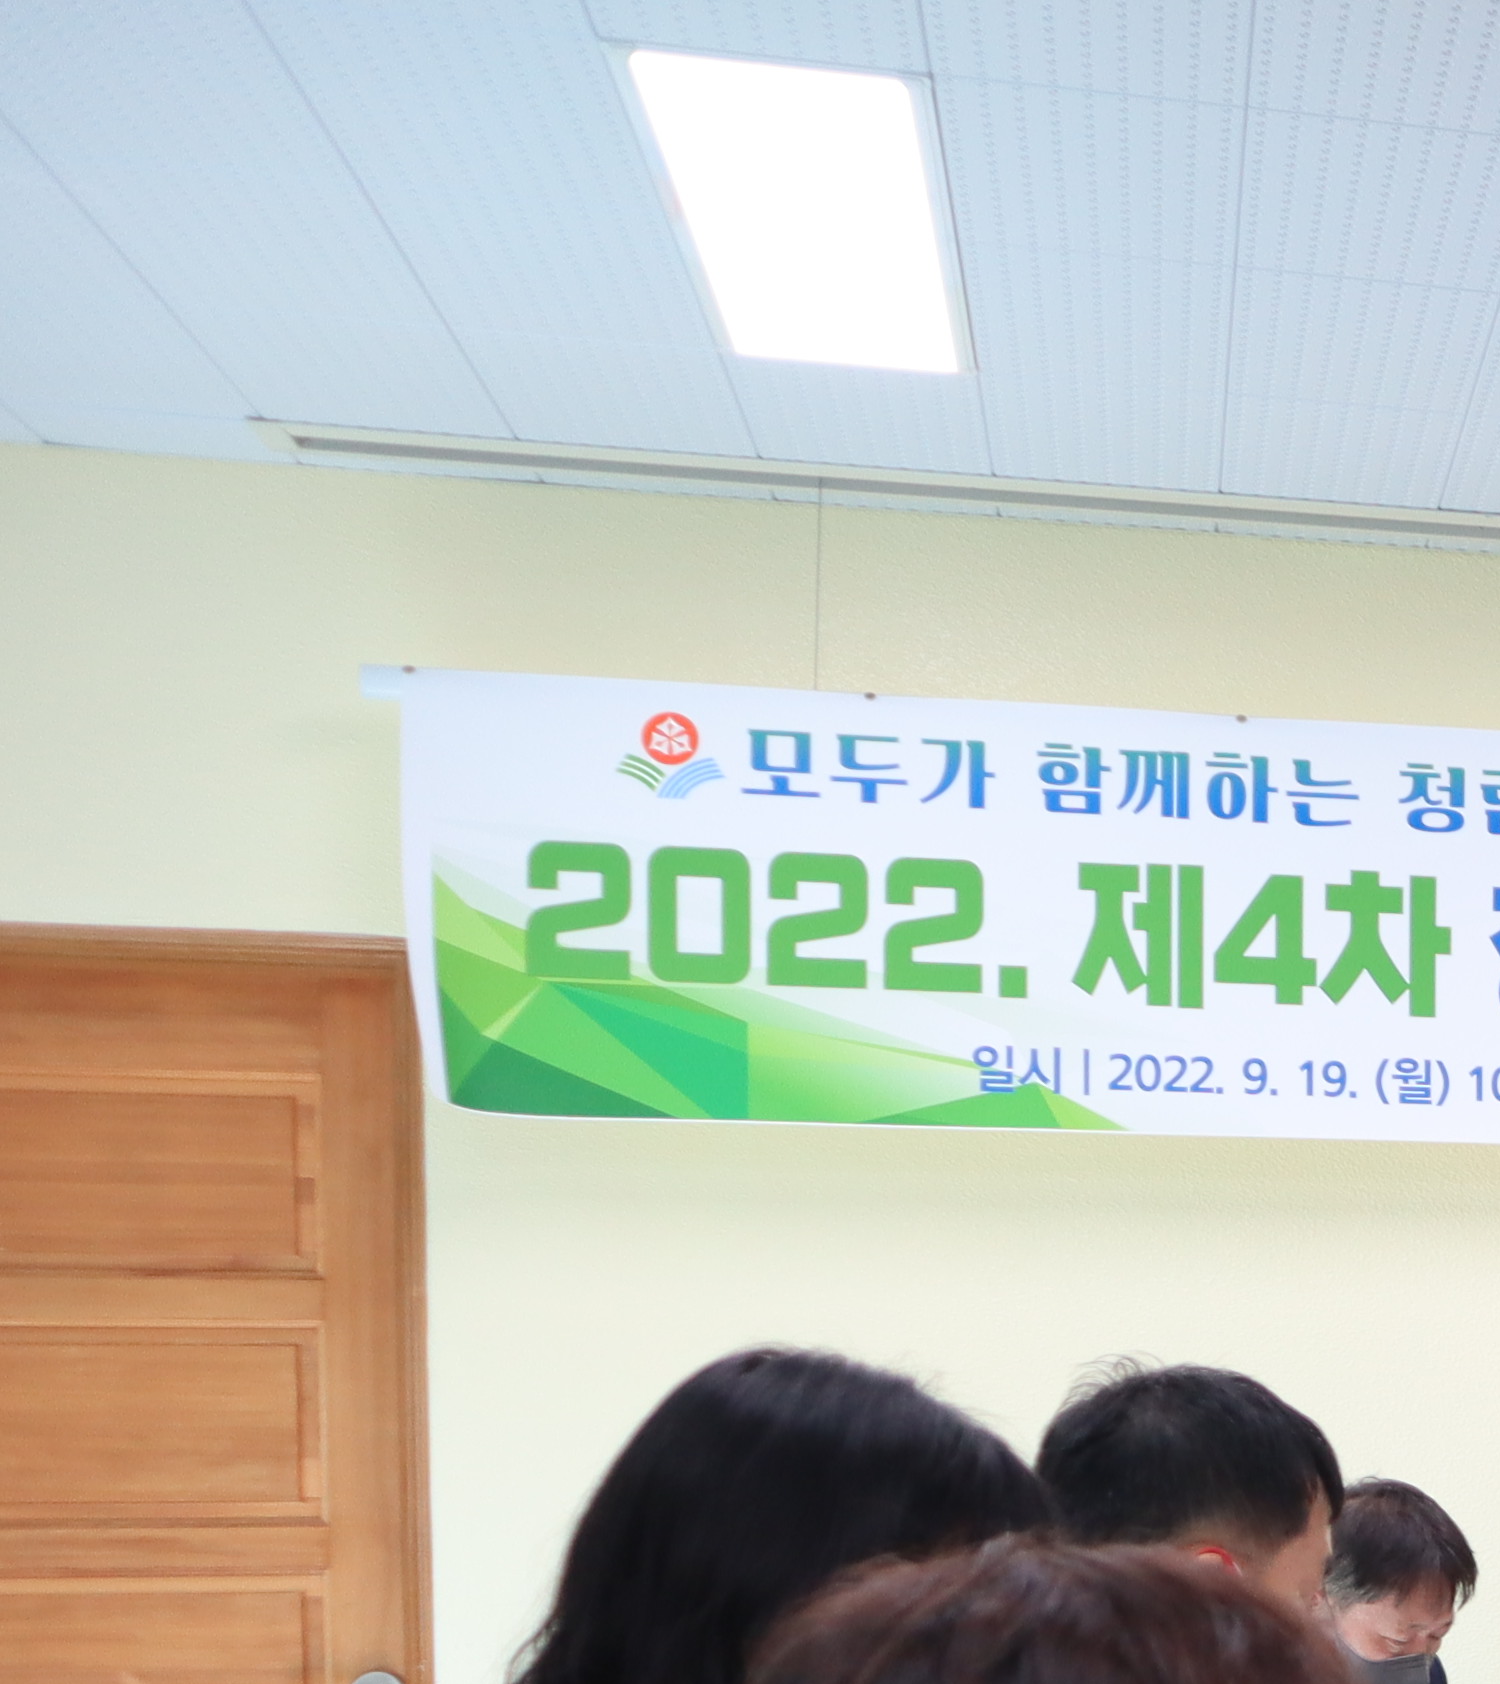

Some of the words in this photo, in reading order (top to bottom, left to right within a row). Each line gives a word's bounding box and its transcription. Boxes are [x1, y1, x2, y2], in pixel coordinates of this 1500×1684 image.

[744, 729, 994, 809] 모두가
[1039, 743, 1359, 827] 함께하는
[524, 840, 1028, 999] 2022.
[1073, 863, 1451, 1018] 제4차
[972, 1045, 1061, 1095] 일시
[1108, 1053, 1224, 1095] 2022.
[1242, 1058, 1278, 1096] 9.
[1300, 1060, 1357, 1099] 19.
[1375, 1057, 1450, 1106] (월)
